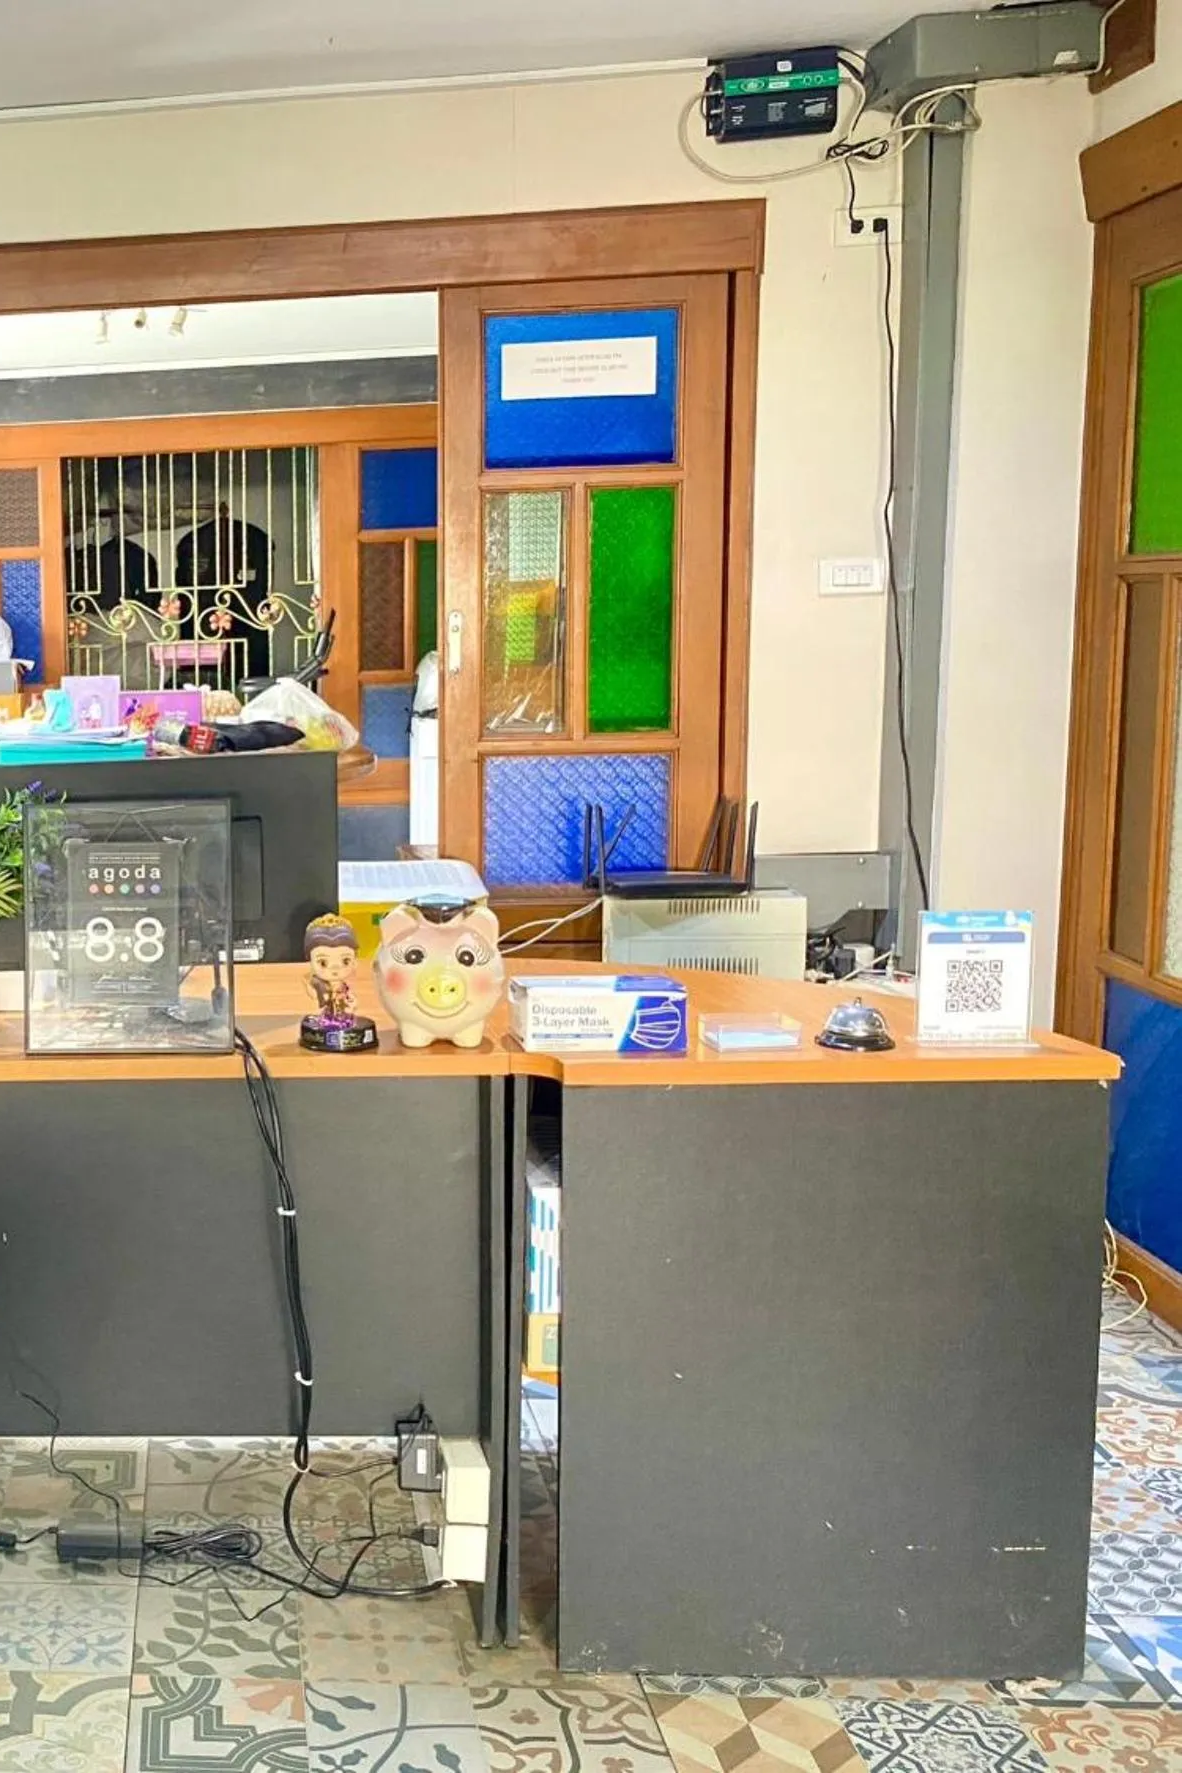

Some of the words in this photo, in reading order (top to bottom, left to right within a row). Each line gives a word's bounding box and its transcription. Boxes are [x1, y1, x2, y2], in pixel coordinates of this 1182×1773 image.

[87, 864, 161, 882] agoda
[85, 916, 165, 963] 8.8
[532, 1003, 598, 1015] Disposable
[532, 1015, 576, 1029] 3-Layer
[577, 1016, 610, 1027] Mask
